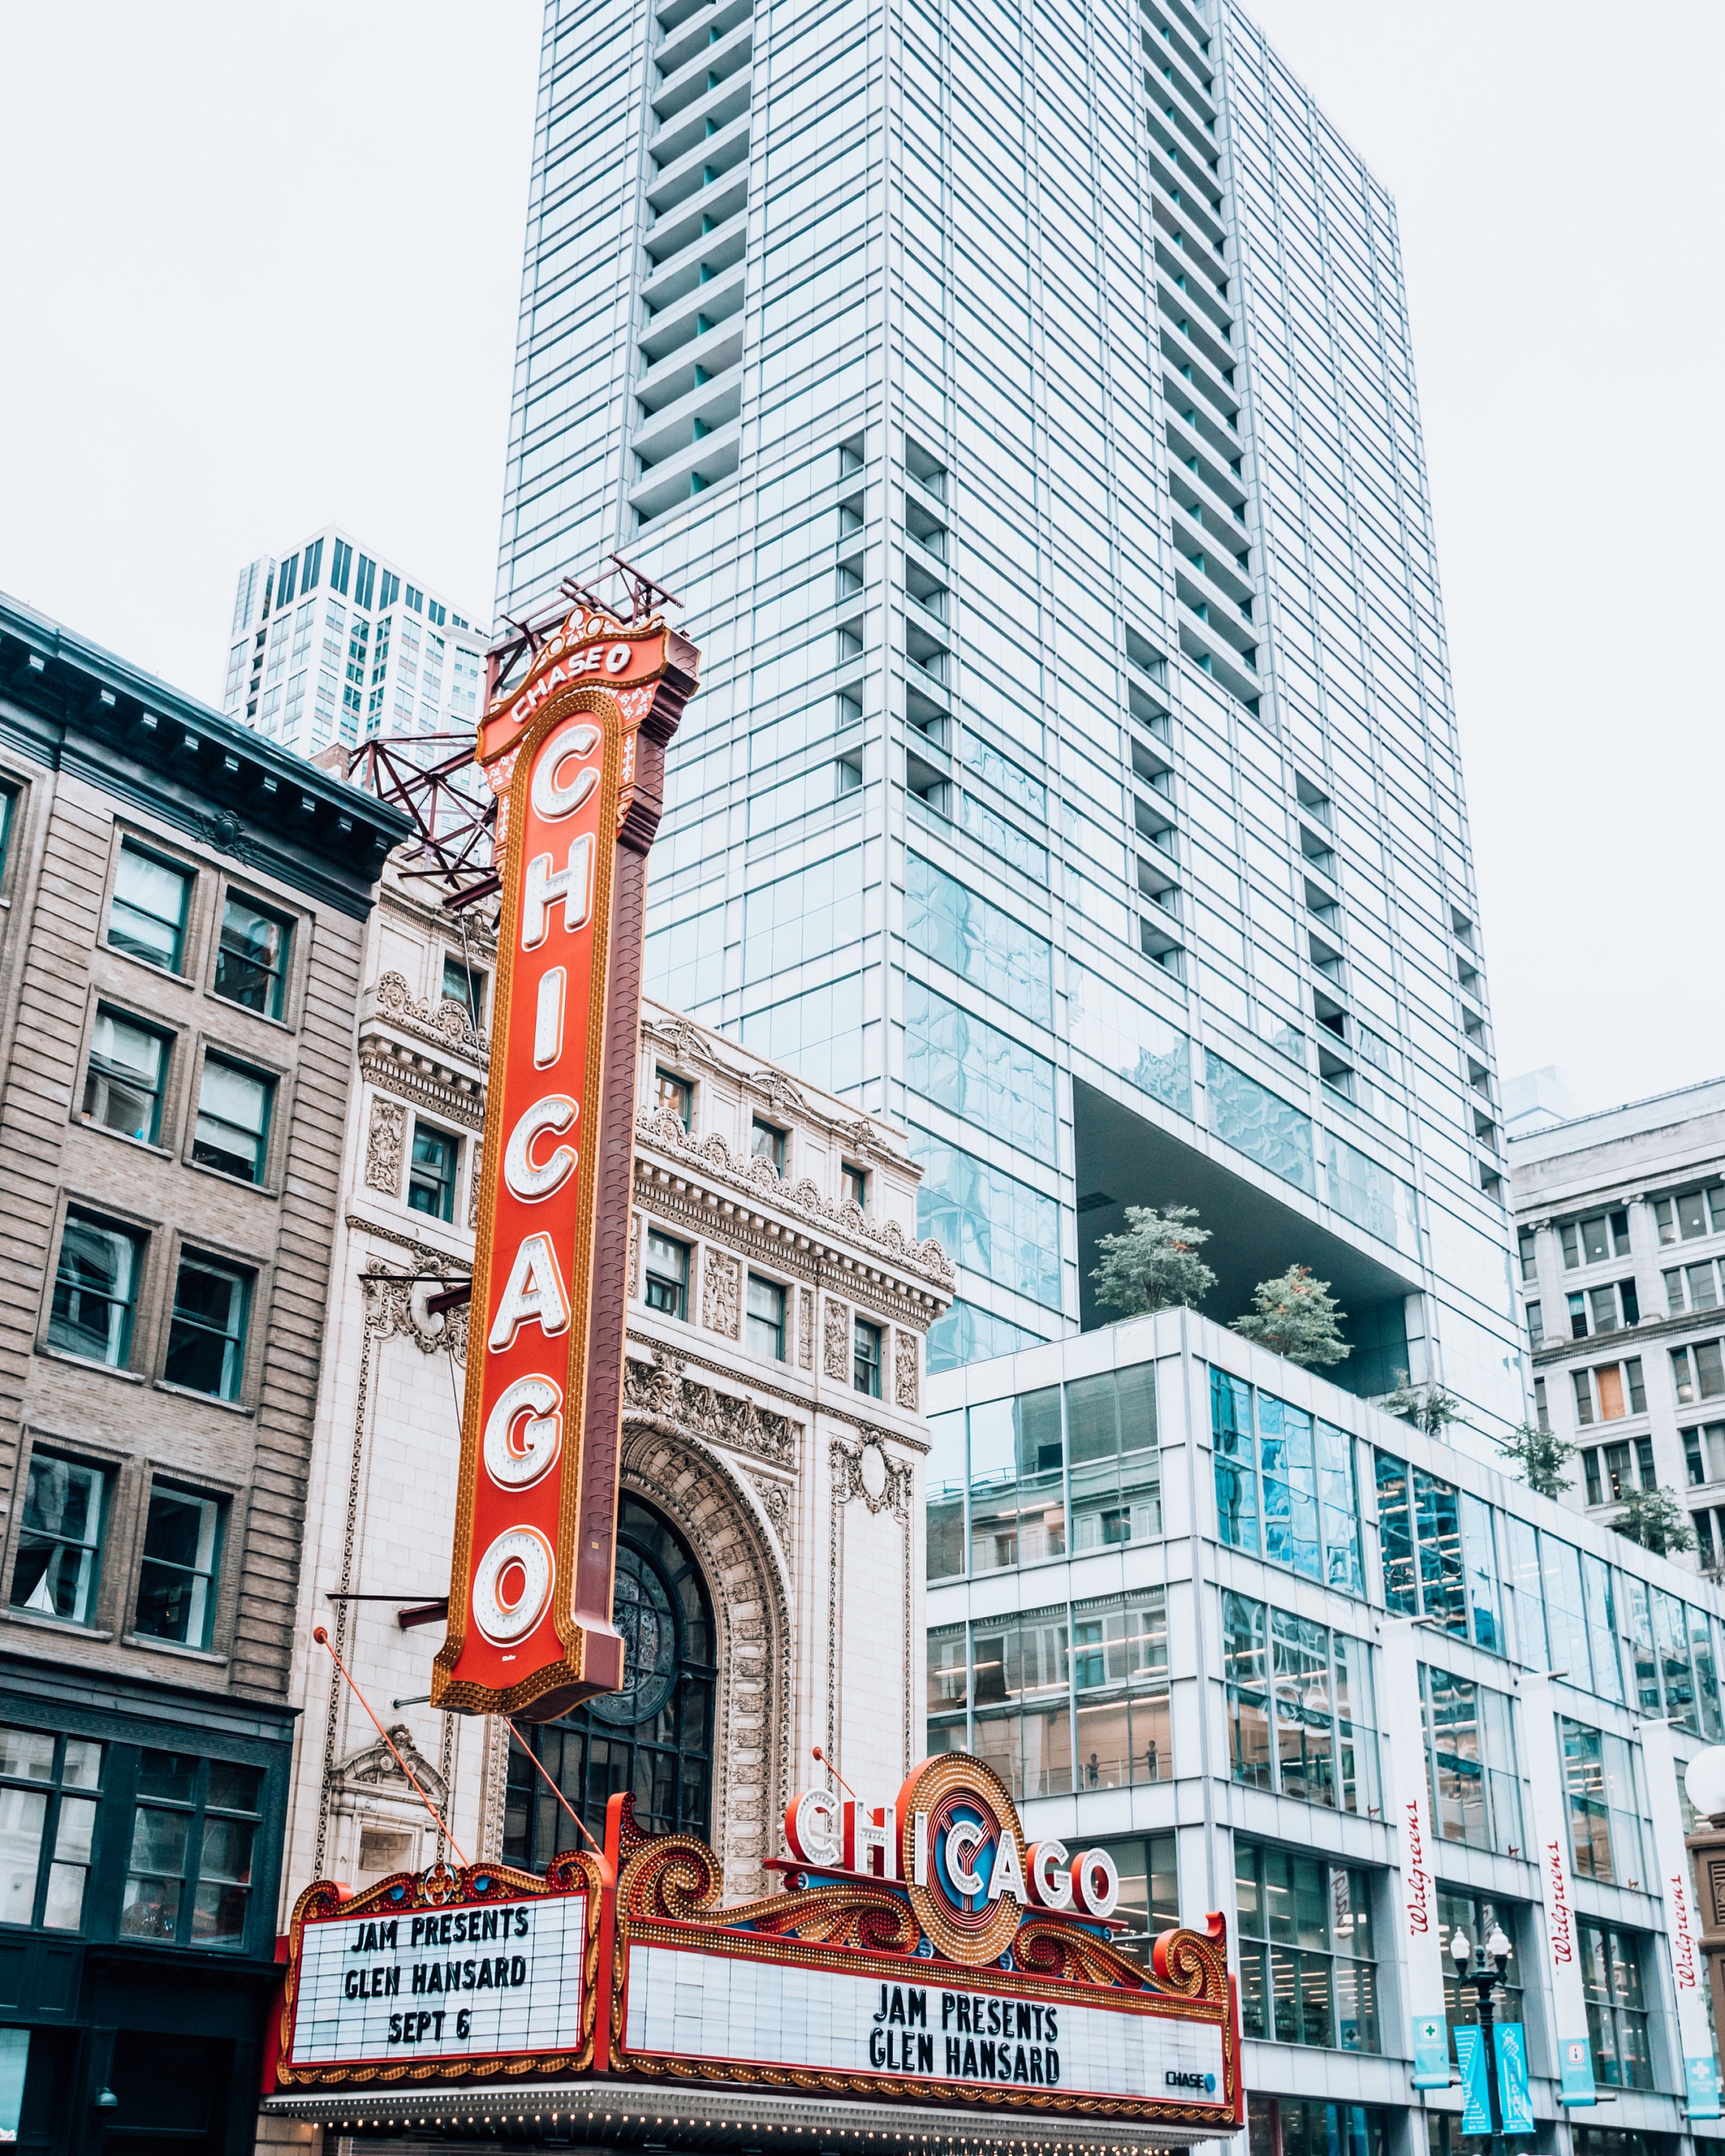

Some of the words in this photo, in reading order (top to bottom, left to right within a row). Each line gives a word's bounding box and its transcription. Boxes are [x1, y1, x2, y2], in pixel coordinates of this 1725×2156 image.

[511, 645, 604, 724] CHASE
[472, 723, 602, 1648] CHICAGO
[788, 1787, 1119, 1918] CHICAGO
[1405, 1799, 1432, 1937] Walgreens
[351, 1920, 397, 1953] JAM
[411, 1906, 530, 1947] PRESENTS
[1547, 1840, 1573, 1966] Walgreens
[1670, 1874, 1696, 1990] Walgreens
[345, 1966, 400, 1999] GLEN
[411, 1955, 526, 1994] HANSARD
[388, 2010, 446, 2043] SEPT
[456, 2008, 472, 2040] 6
[873, 1984, 927, 2028] JAM
[942, 1991, 1059, 2042] PRESENTS
[870, 2027, 934, 2073] GLEN
[946, 2035, 1060, 2084] HANSARD
[1165, 2070, 1205, 2088] CHASE
